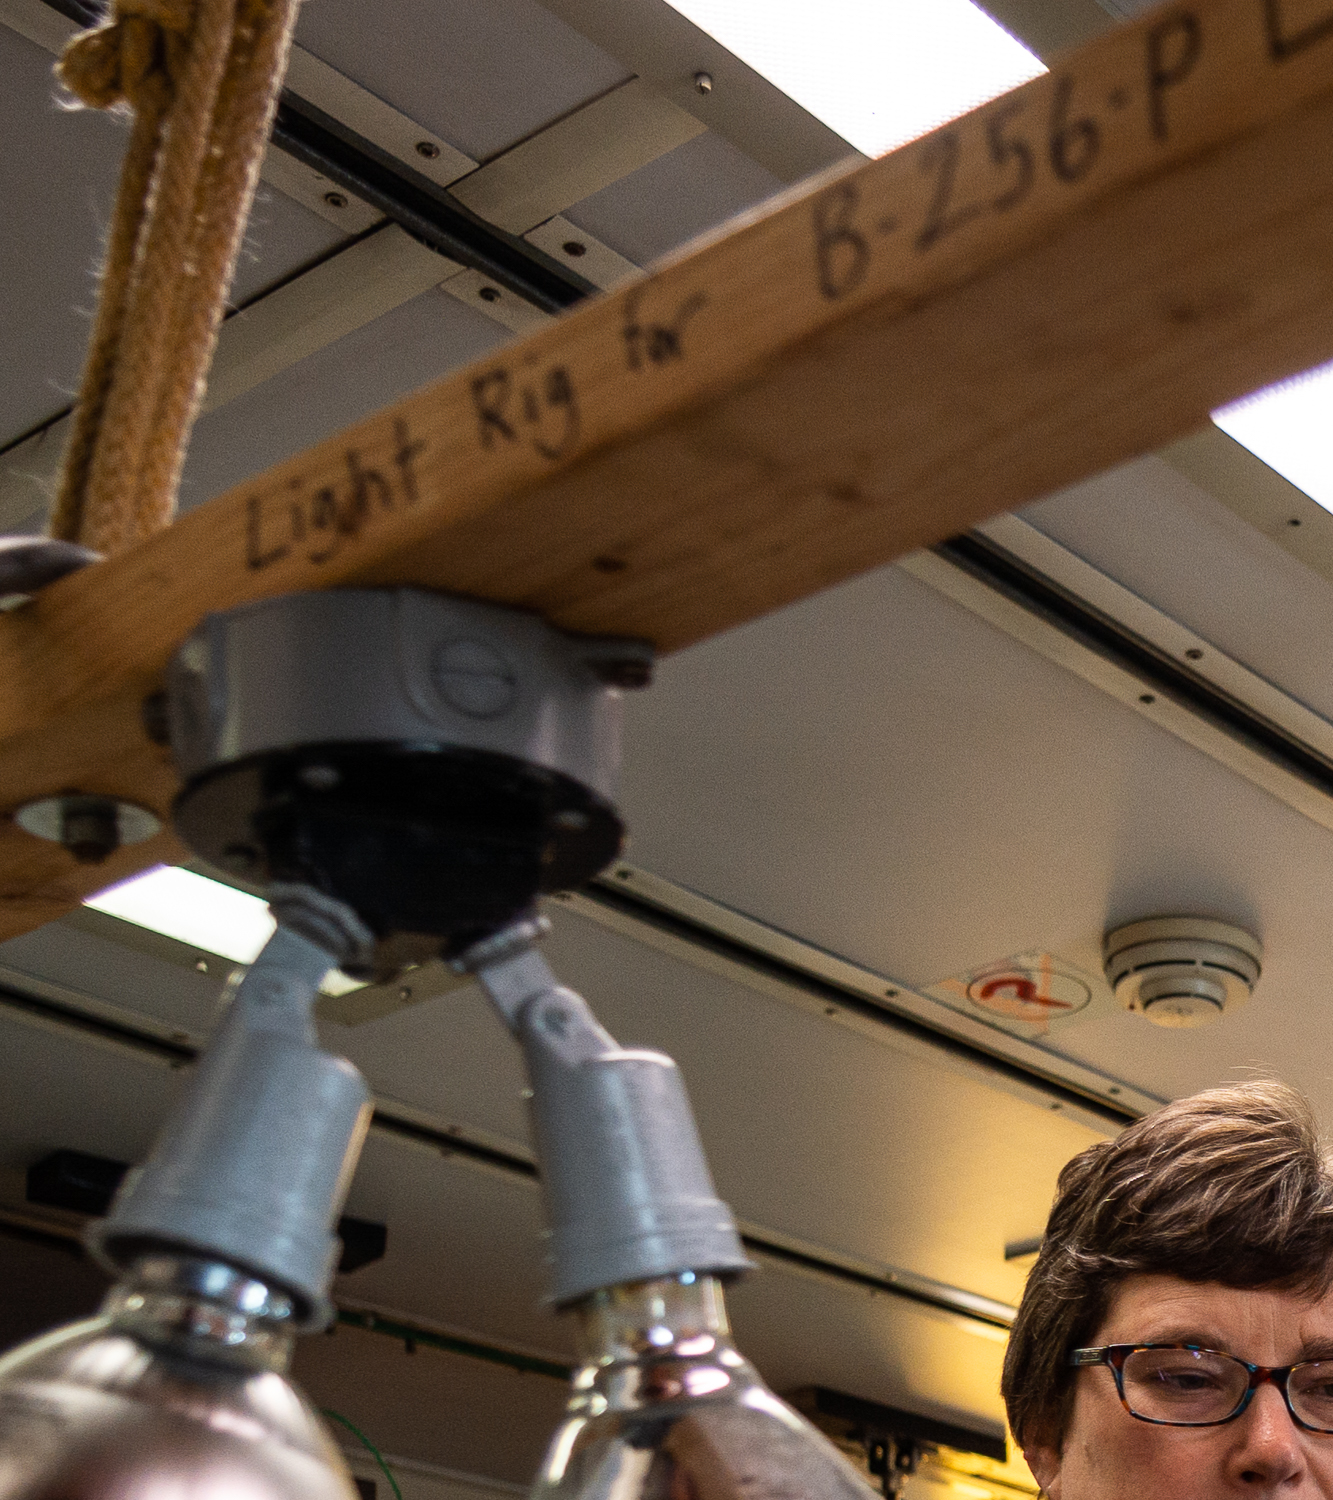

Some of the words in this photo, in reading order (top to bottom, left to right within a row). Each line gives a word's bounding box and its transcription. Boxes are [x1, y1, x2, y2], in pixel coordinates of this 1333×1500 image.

[246, 417, 428, 571] Light
[469, 353, 583, 462] Rig
[621, 272, 711, 374] for
